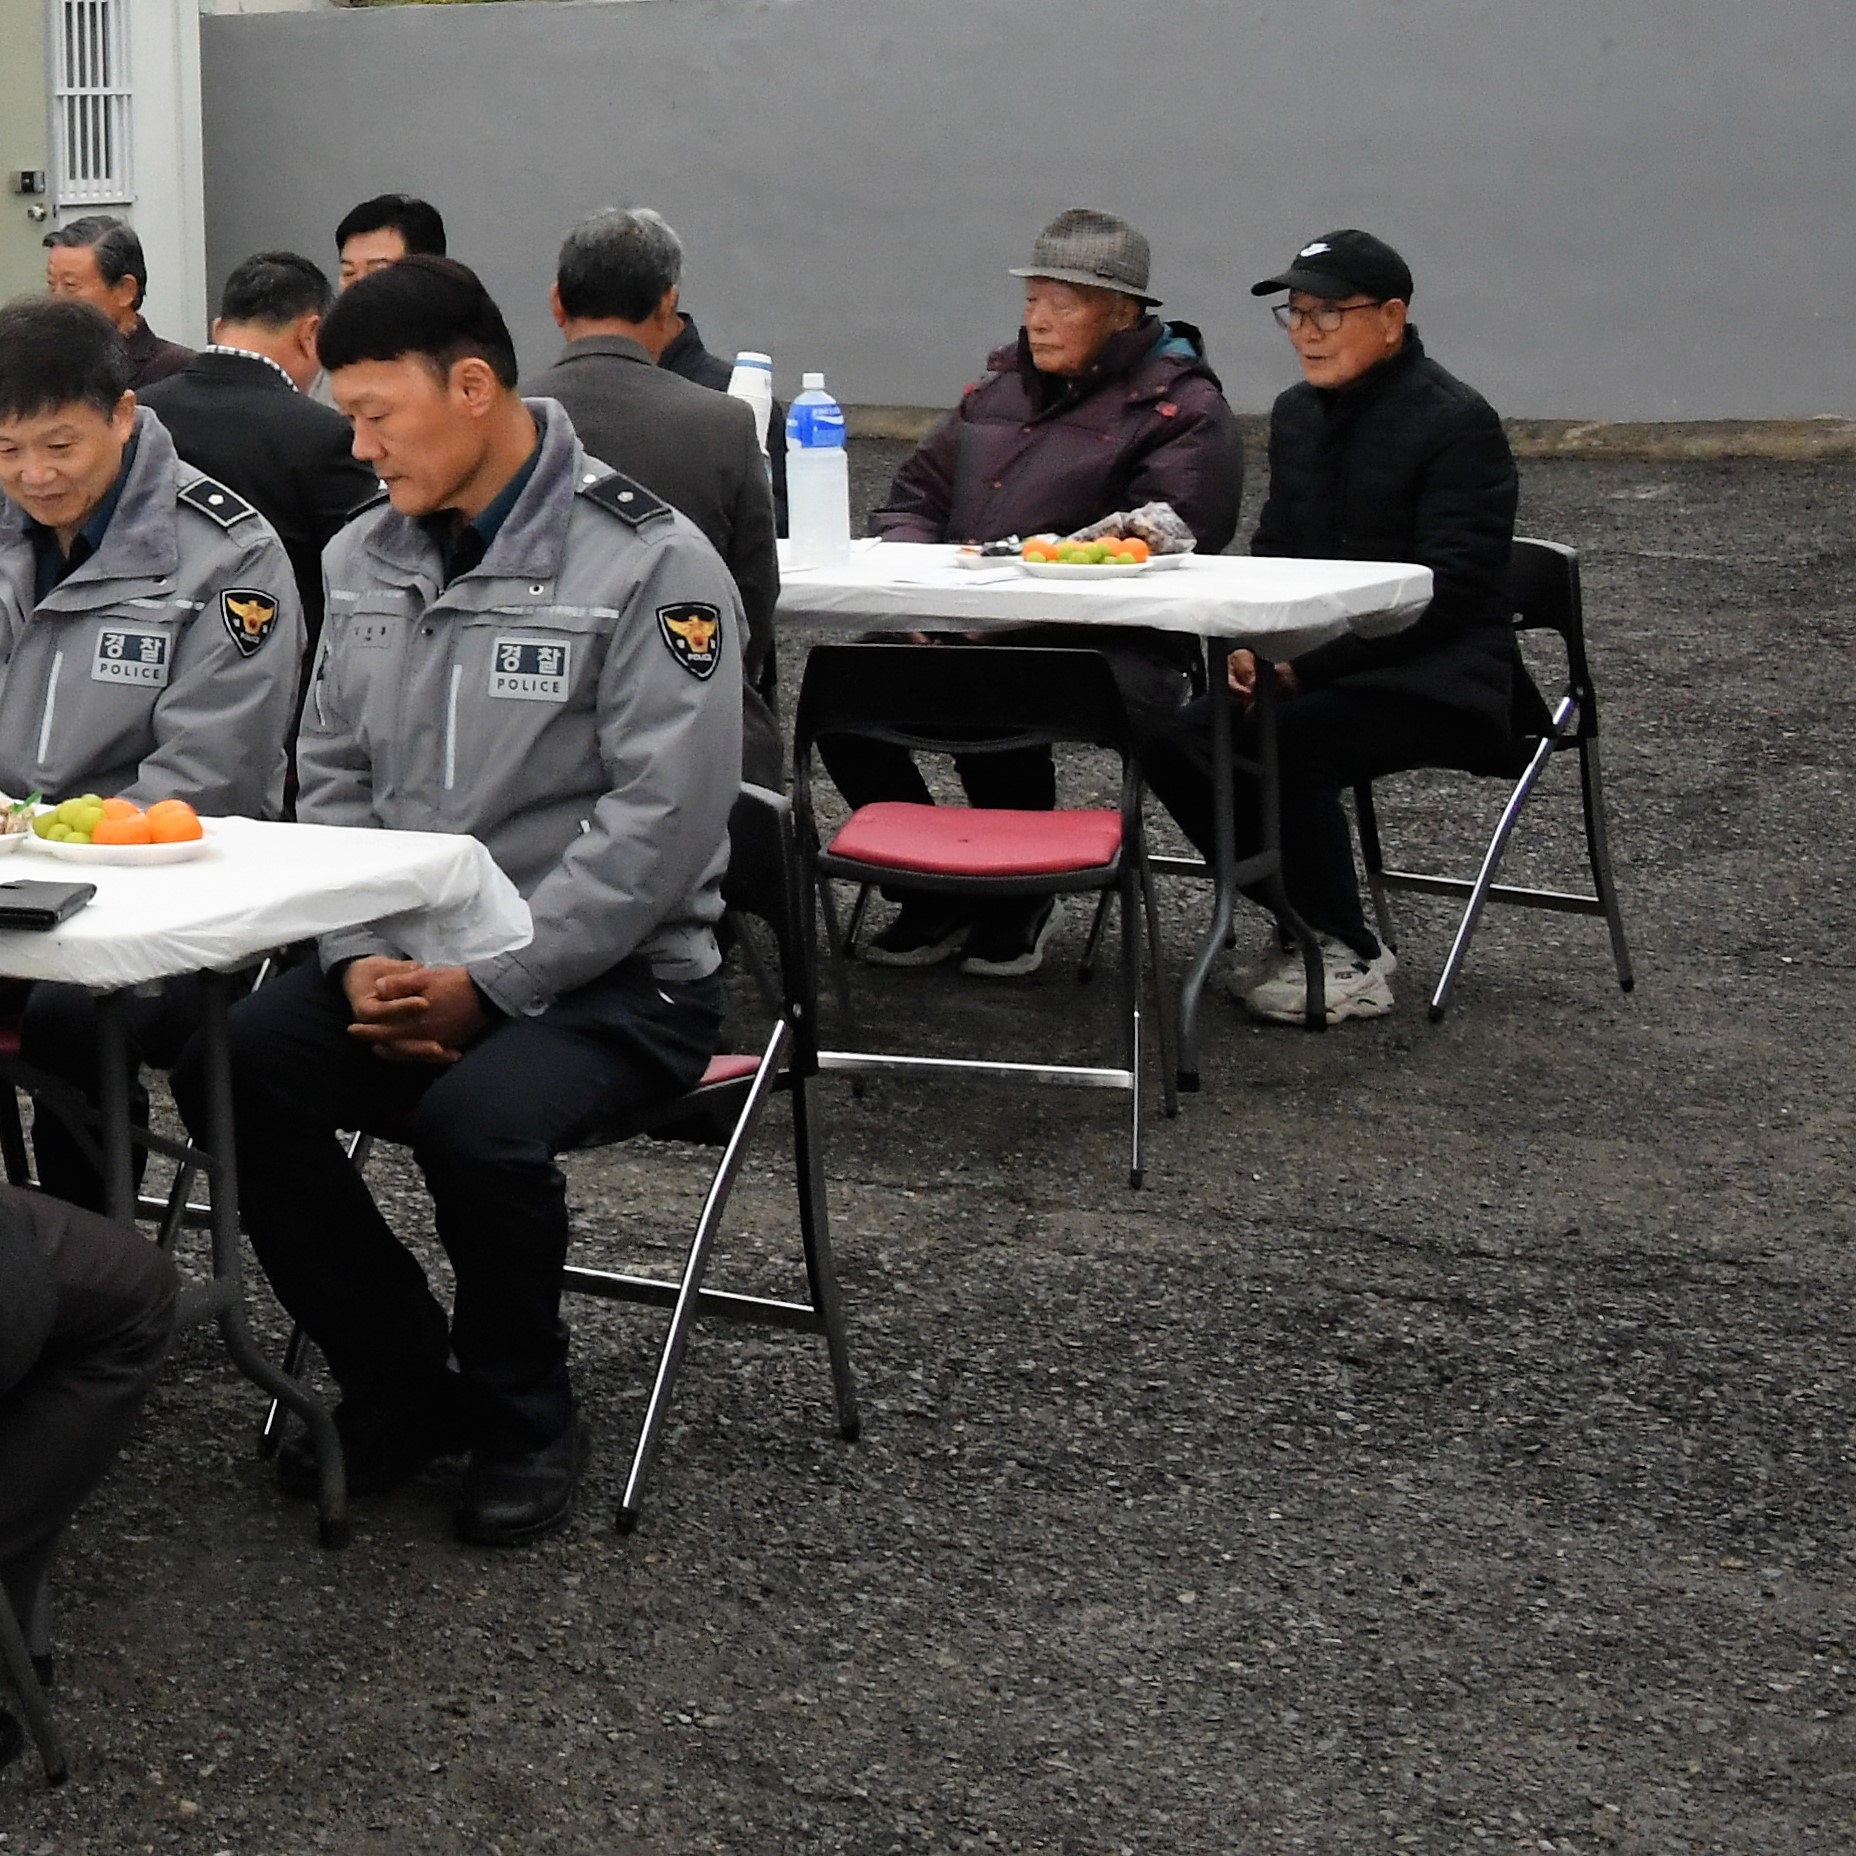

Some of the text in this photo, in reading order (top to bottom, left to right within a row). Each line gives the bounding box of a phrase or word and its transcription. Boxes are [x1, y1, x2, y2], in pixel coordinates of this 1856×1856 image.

[104, 633, 162, 663] 경찰
[99, 663, 160, 680] POLICE
[500, 645, 562, 675] 경찰
[497, 677, 561, 694] POLICE
